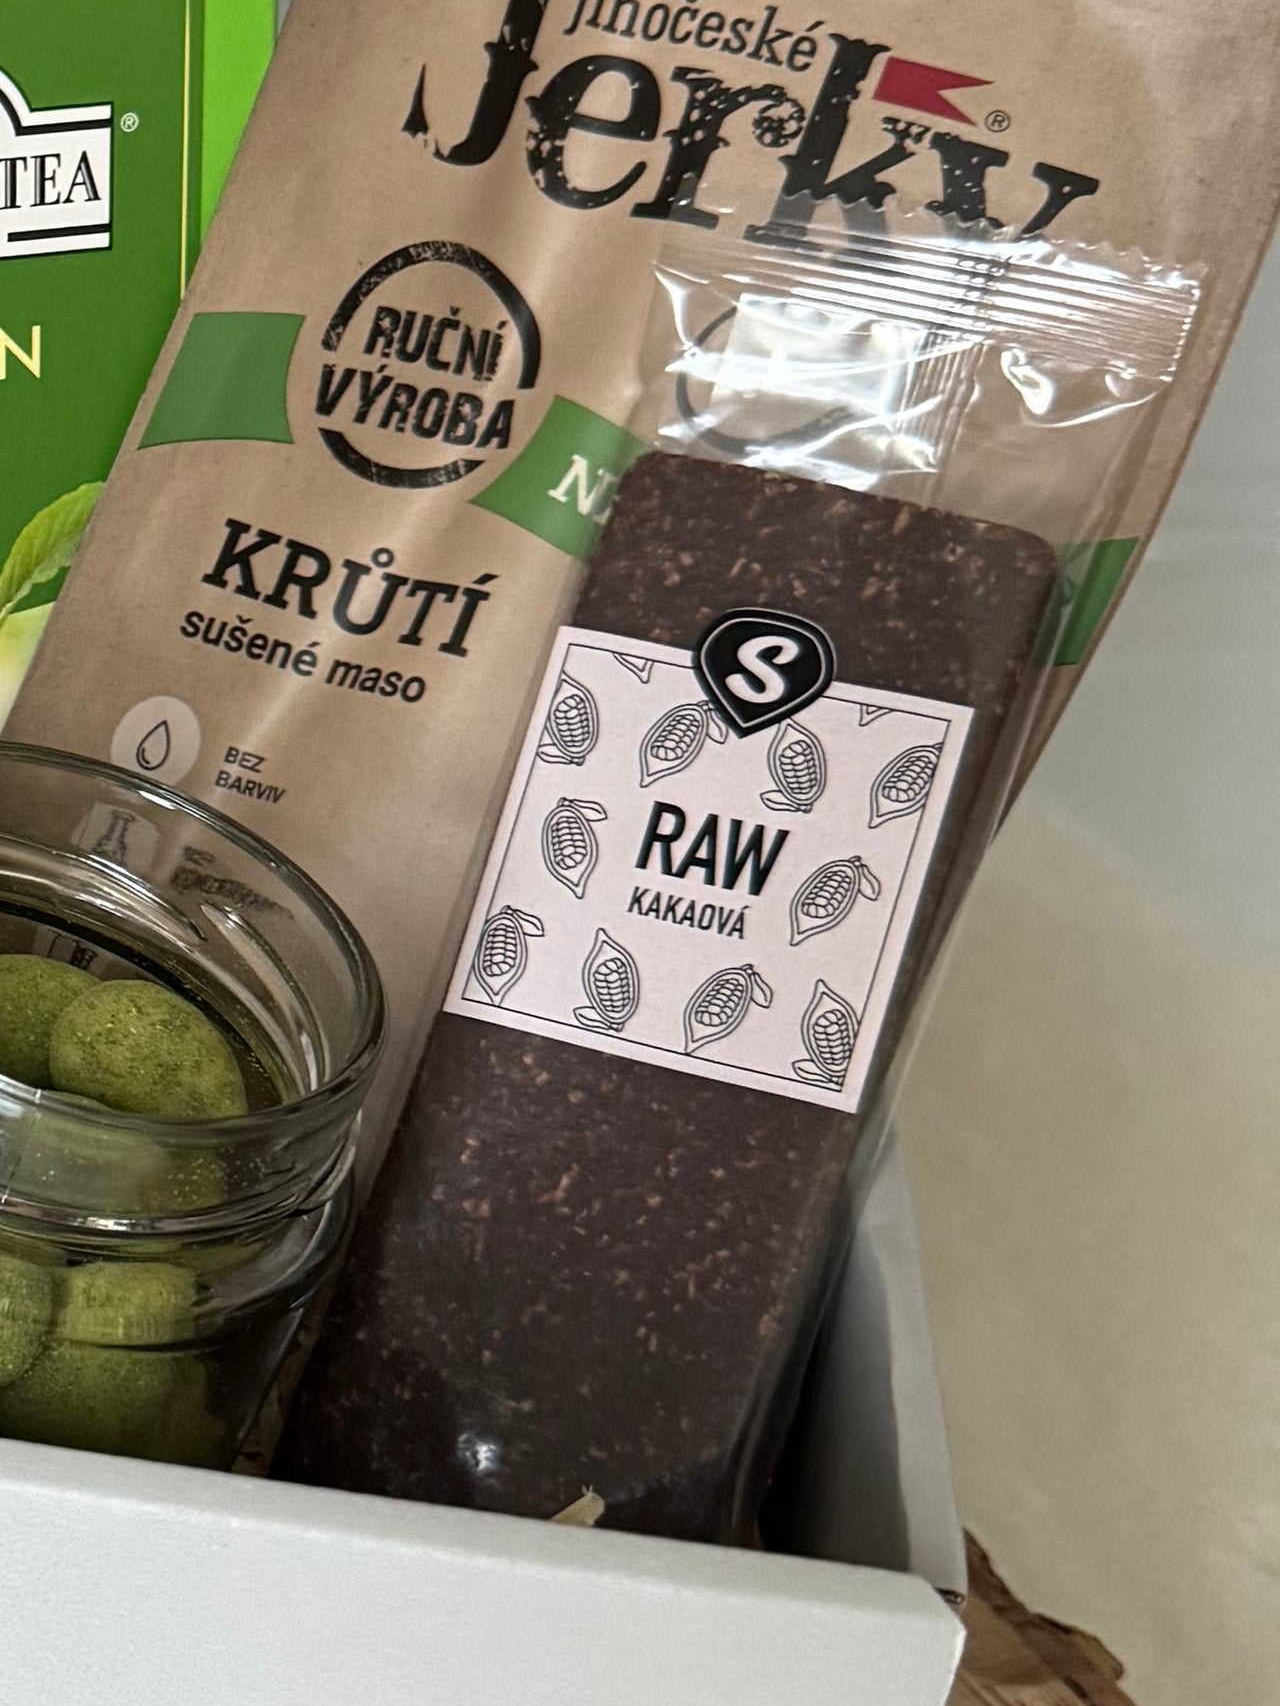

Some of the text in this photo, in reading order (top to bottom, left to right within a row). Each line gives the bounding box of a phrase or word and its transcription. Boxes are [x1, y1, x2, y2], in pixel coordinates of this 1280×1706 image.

[362, 305, 507, 382] RUČNÍ
[315, 363, 516, 450] VÝROBA
[201, 518, 499, 657] KRŮTÍ
[179, 609, 427, 703] sušené maso
[215, 770, 287, 804] BARVIV
[224, 746, 266, 774] BEZ
[633, 801, 790, 897] RAW
[627, 887, 752, 940] KAKAOVÁ
